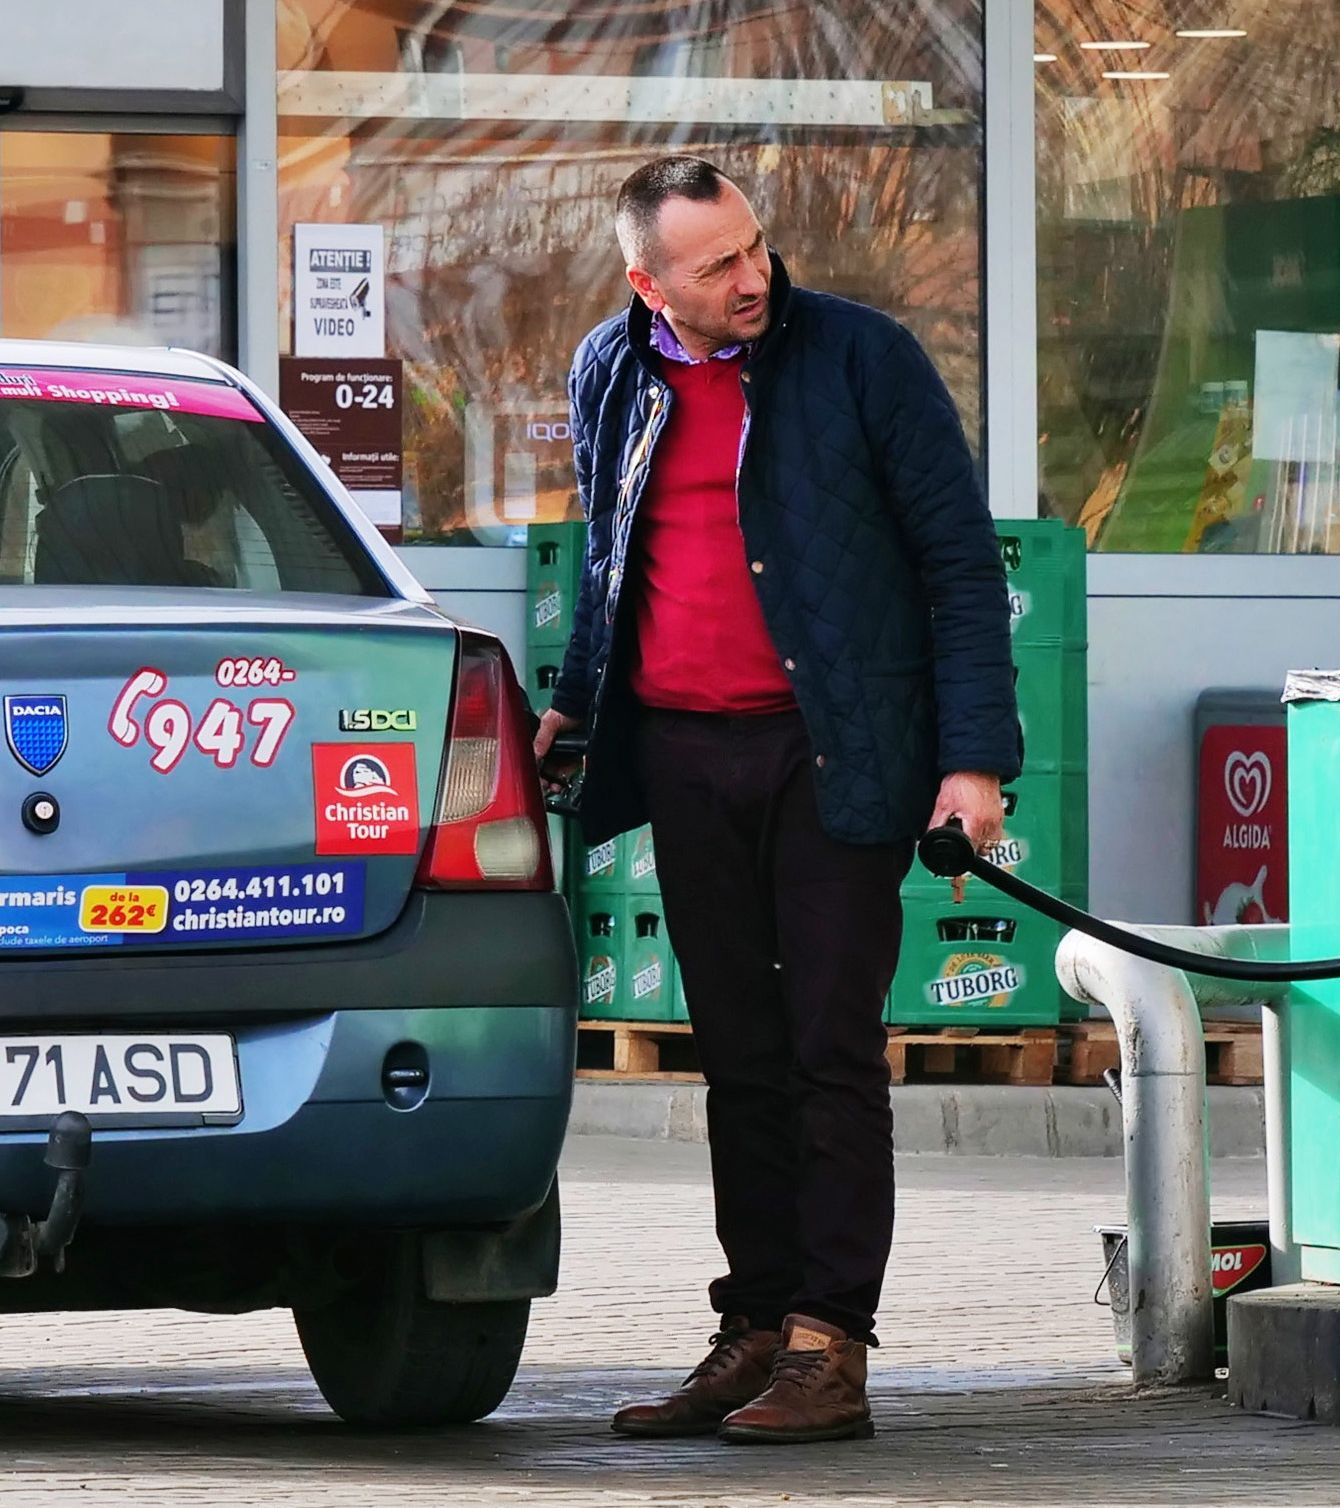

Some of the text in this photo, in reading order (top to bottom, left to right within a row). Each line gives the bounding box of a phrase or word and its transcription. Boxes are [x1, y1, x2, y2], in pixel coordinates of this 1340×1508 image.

[313, 317, 355, 336] VIDEO
[301, 372, 335, 384] Program
[335, 373, 345, 382] de
[47, 384, 180, 410] Shopping!
[335, 384, 395, 409] 0-24
[526, 422, 571, 442] IQO
[380, 452, 400, 462] utile:
[216, 657, 295, 687] 0264-
[13, 705, 61, 716] DACIA
[146, 699, 295, 773] 947
[325, 802, 410, 822] Christian
[346, 822, 389, 840] Tour
[1223, 825, 1271, 850] ALGIDA
[0, 885, 77, 907] rmaris
[110, 892, 140, 903] de la
[174, 872, 345, 902] 0264.411.101
[90, 903, 157, 927] 262€
[173, 905, 346, 931] christiantour.ro
[25, 935, 52, 945] taxele
[54, 934, 67, 945] de
[69, 934, 109, 947] aeroport
[930, 967, 1018, 1003] TUBORG
[5, 1043, 214, 1106] 71 ASD
